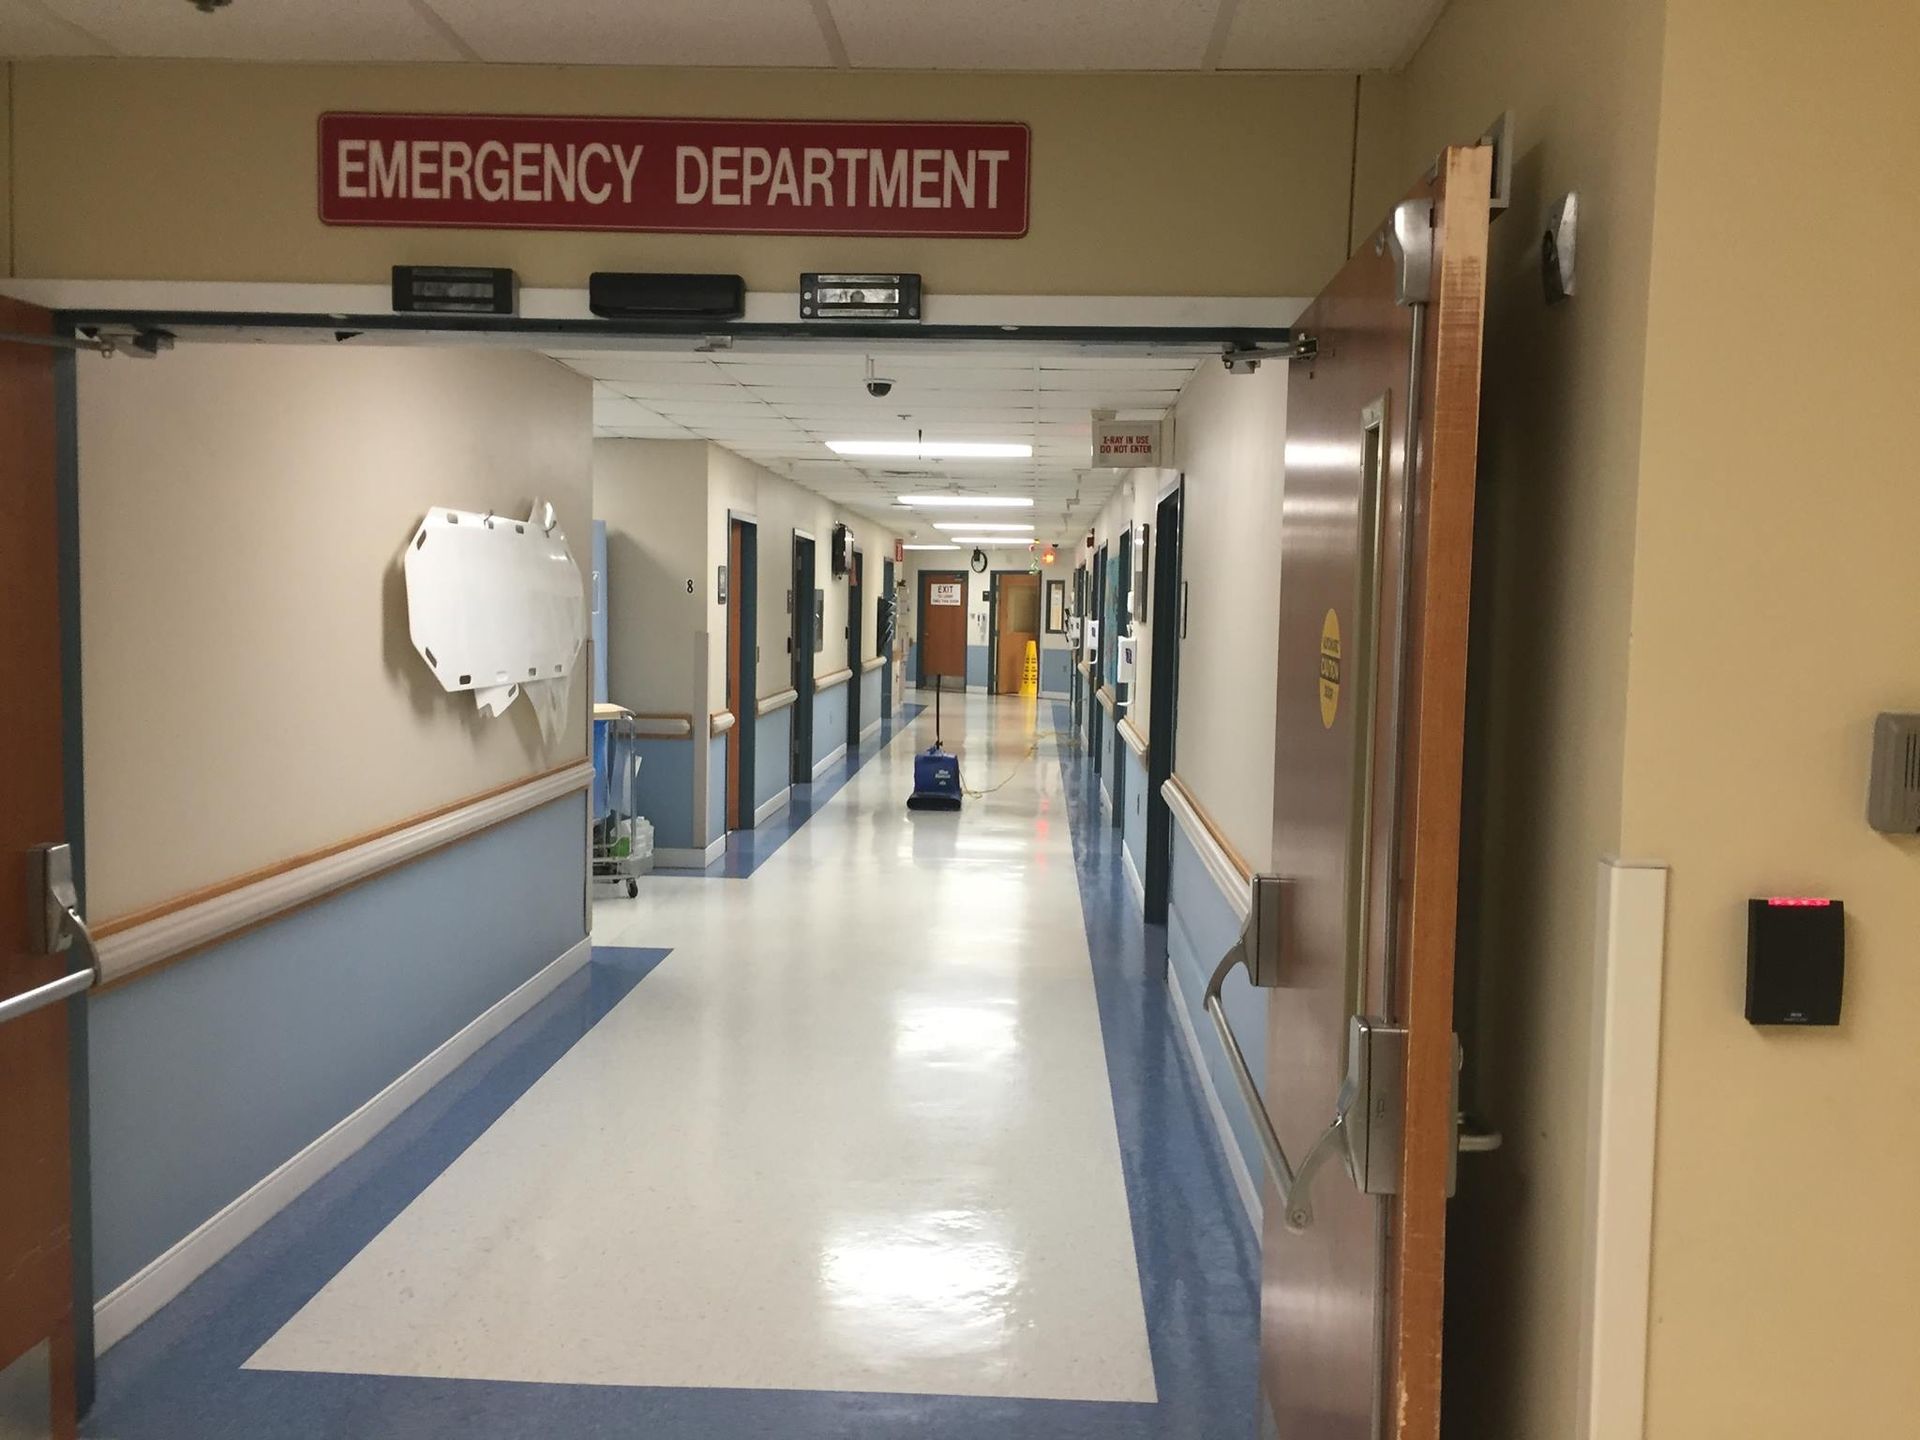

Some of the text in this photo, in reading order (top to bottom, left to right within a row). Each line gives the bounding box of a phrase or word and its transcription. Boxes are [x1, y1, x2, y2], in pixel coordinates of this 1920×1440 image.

[337, 140, 1010, 210] EMERGENCY DEPARTMENT
[1103, 436, 1149, 444] X-RAY IN USE
[1100, 445, 1152, 454] DO NOT ENTER
[687, 579, 693, 593] 8
[937, 585, 953, 594] EXIT
